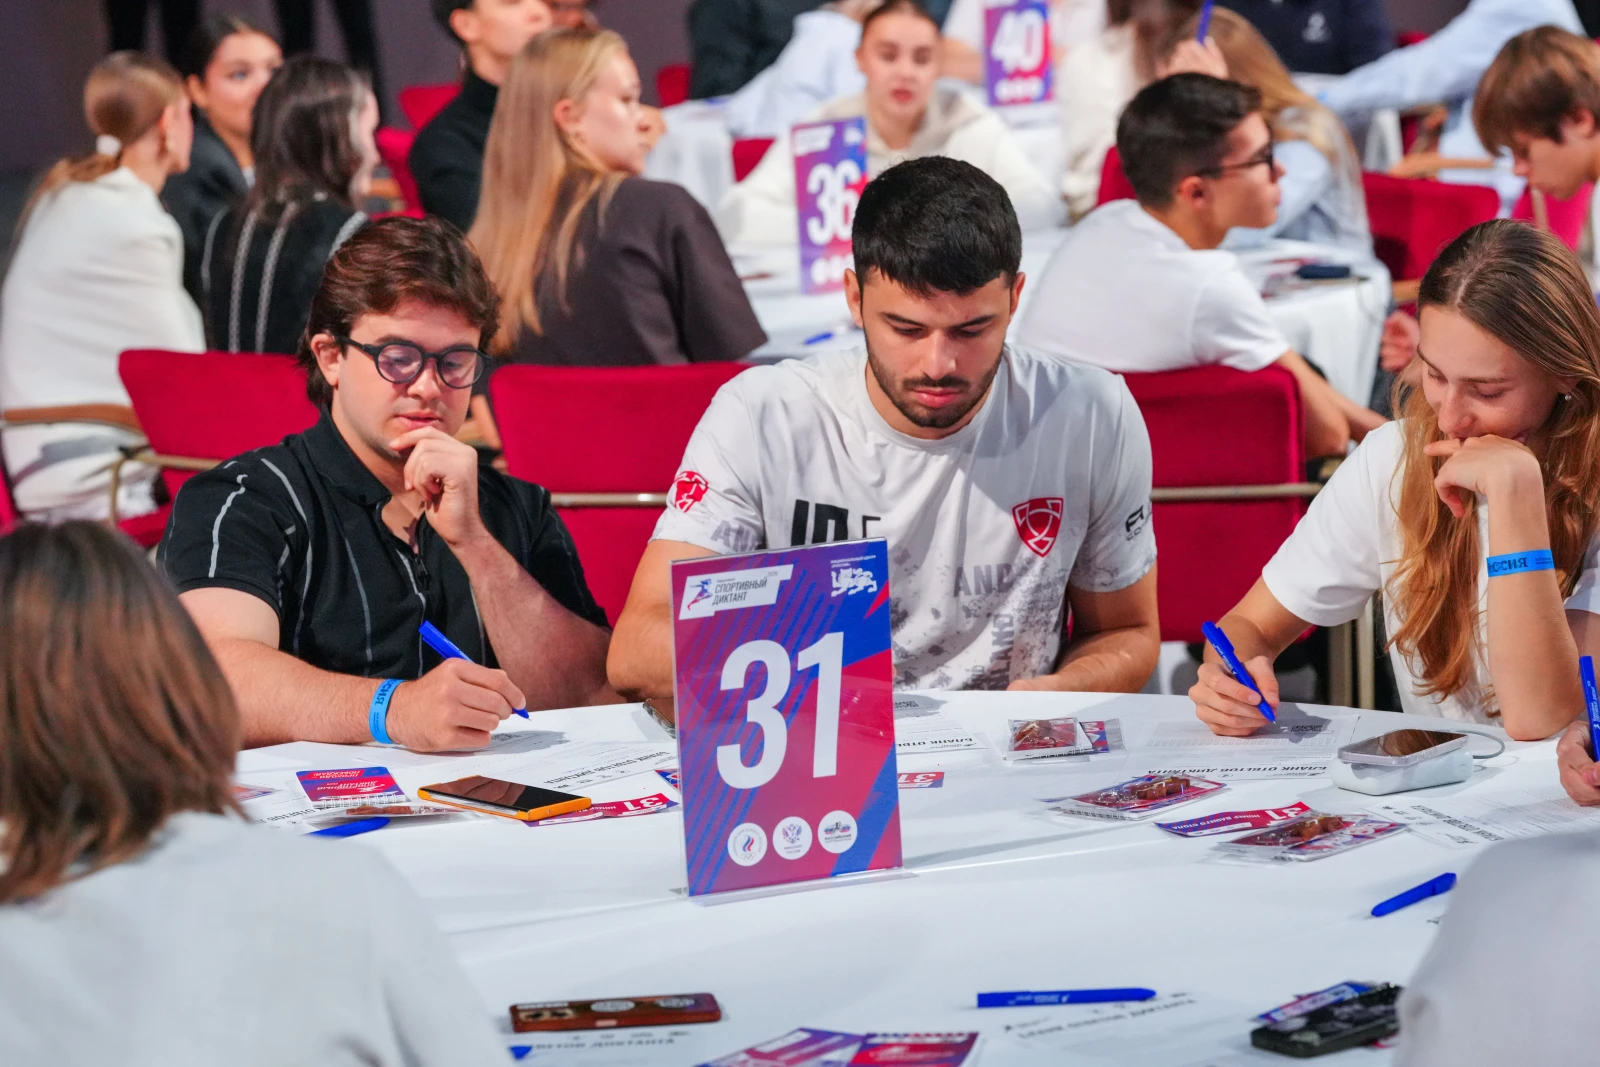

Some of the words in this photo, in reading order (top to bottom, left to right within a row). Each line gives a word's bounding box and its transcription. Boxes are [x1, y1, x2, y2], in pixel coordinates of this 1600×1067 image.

[991, 9, 1043, 74] 40
[807, 158, 862, 246] 36
[714, 576, 768, 594] СПОРТИВНЫЙ
[711, 591, 748, 606] ДИКТАНТ
[716, 631, 844, 789] 31
[898, 773, 937, 783] 31
[623, 797, 660, 811] 31
[1265, 807, 1303, 821] 31
